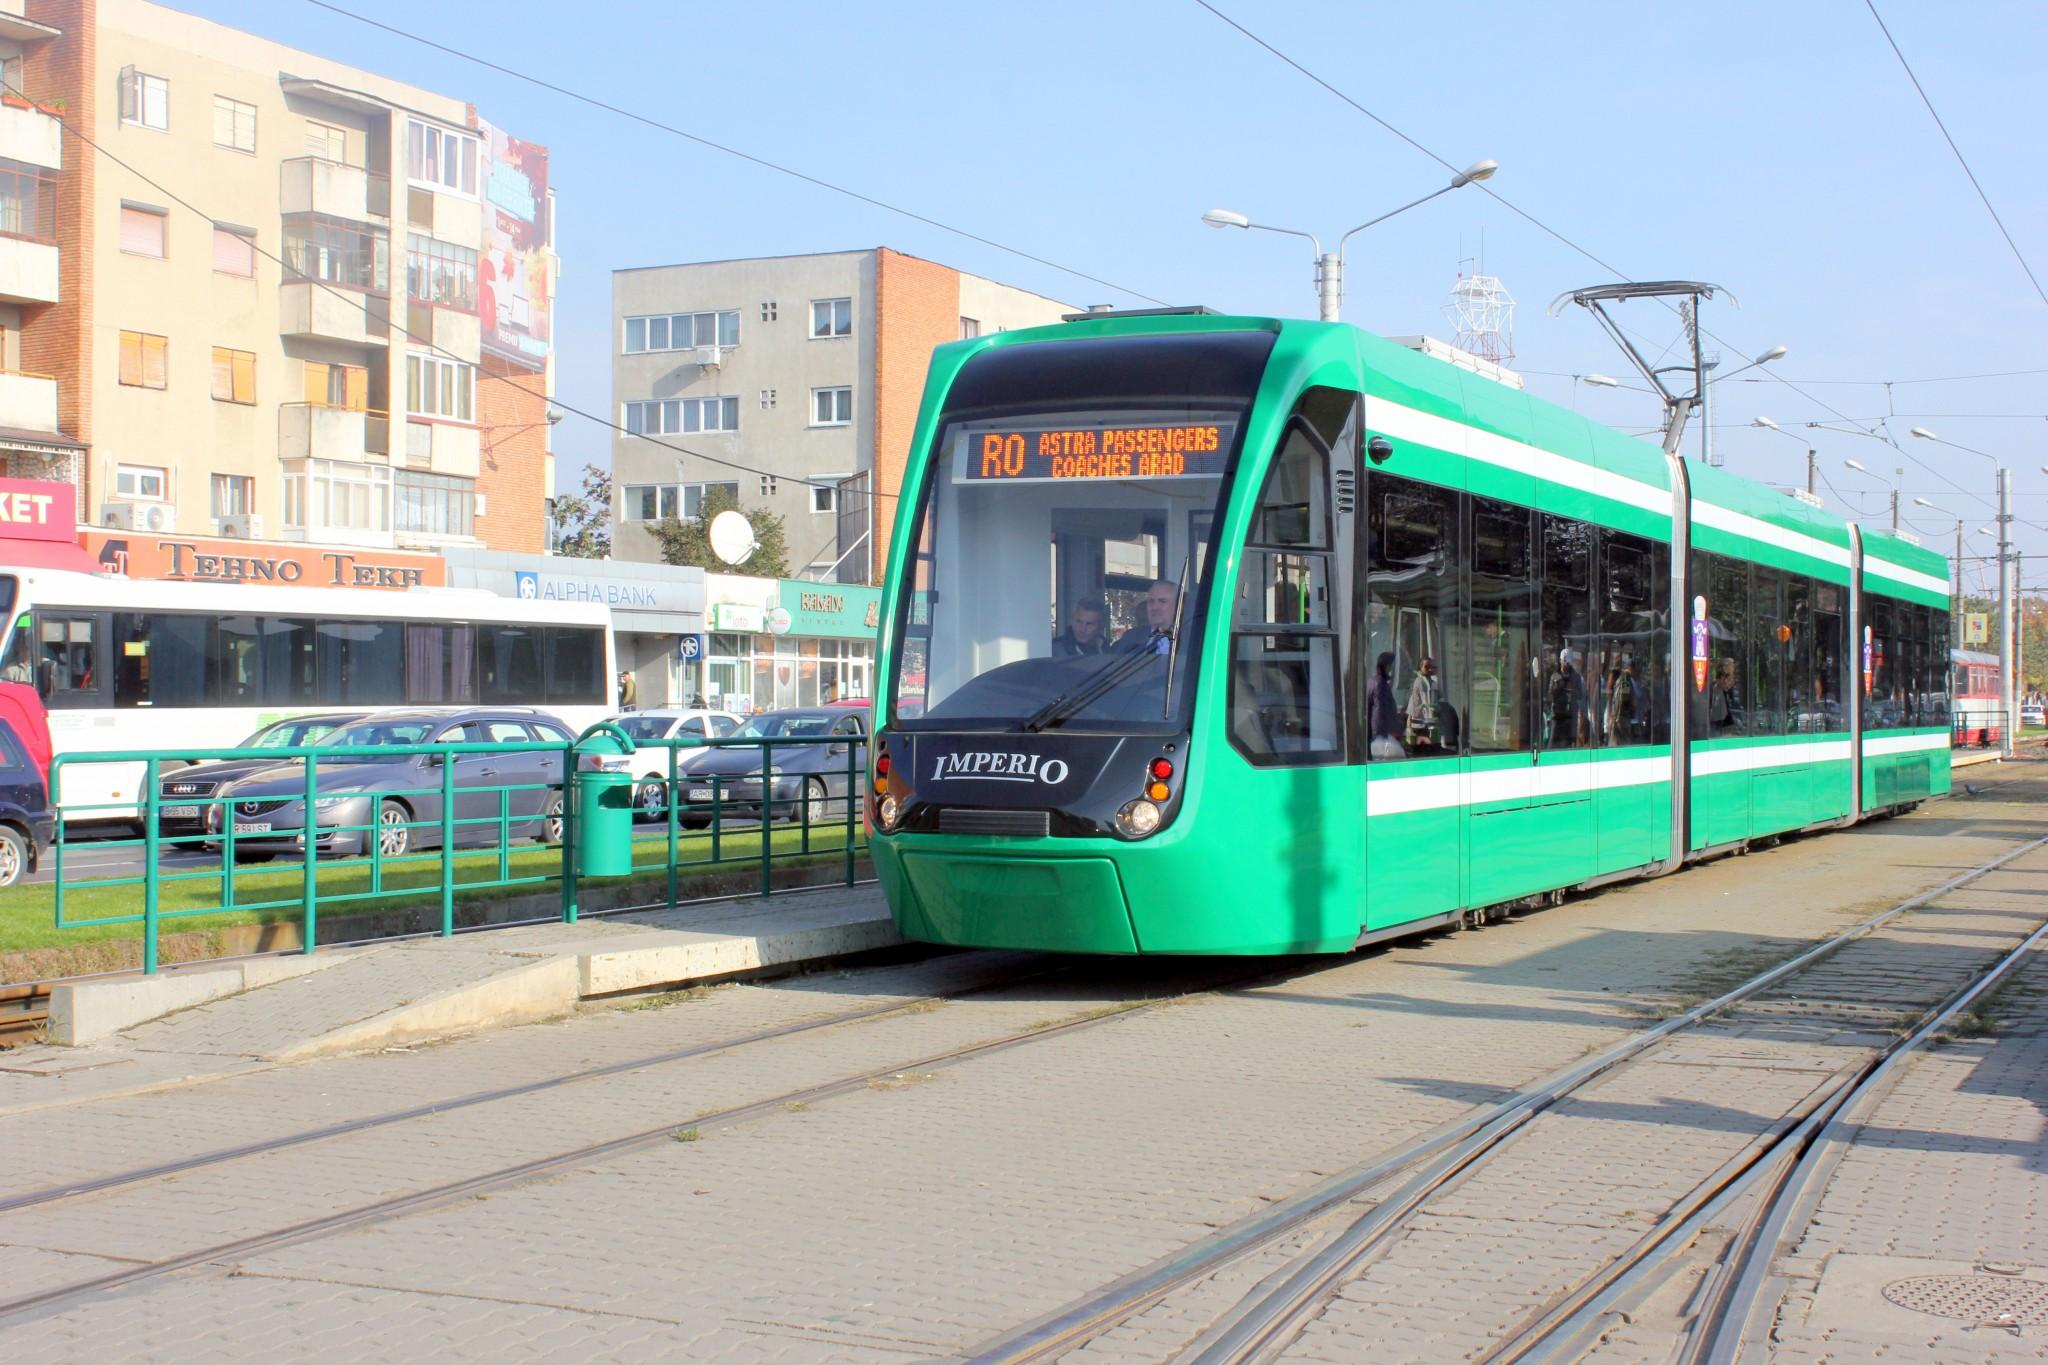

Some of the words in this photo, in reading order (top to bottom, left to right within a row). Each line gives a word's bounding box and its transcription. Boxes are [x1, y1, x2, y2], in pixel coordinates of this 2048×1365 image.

[981, 433, 1025, 477] RO
[1039, 431, 1096, 456] ASTRA
[1102, 426, 1219, 455] PASSENGERS
[1052, 453, 1131, 478] COACHES
[1137, 452, 1185, 476] ARAD
[158, 541, 303, 582] TEHNO
[322, 552, 424, 588] TEKH
[543, 580, 604, 602] ALPHA
[607, 584, 657, 606] BANK
[930, 752, 1069, 785] IMPERIO
